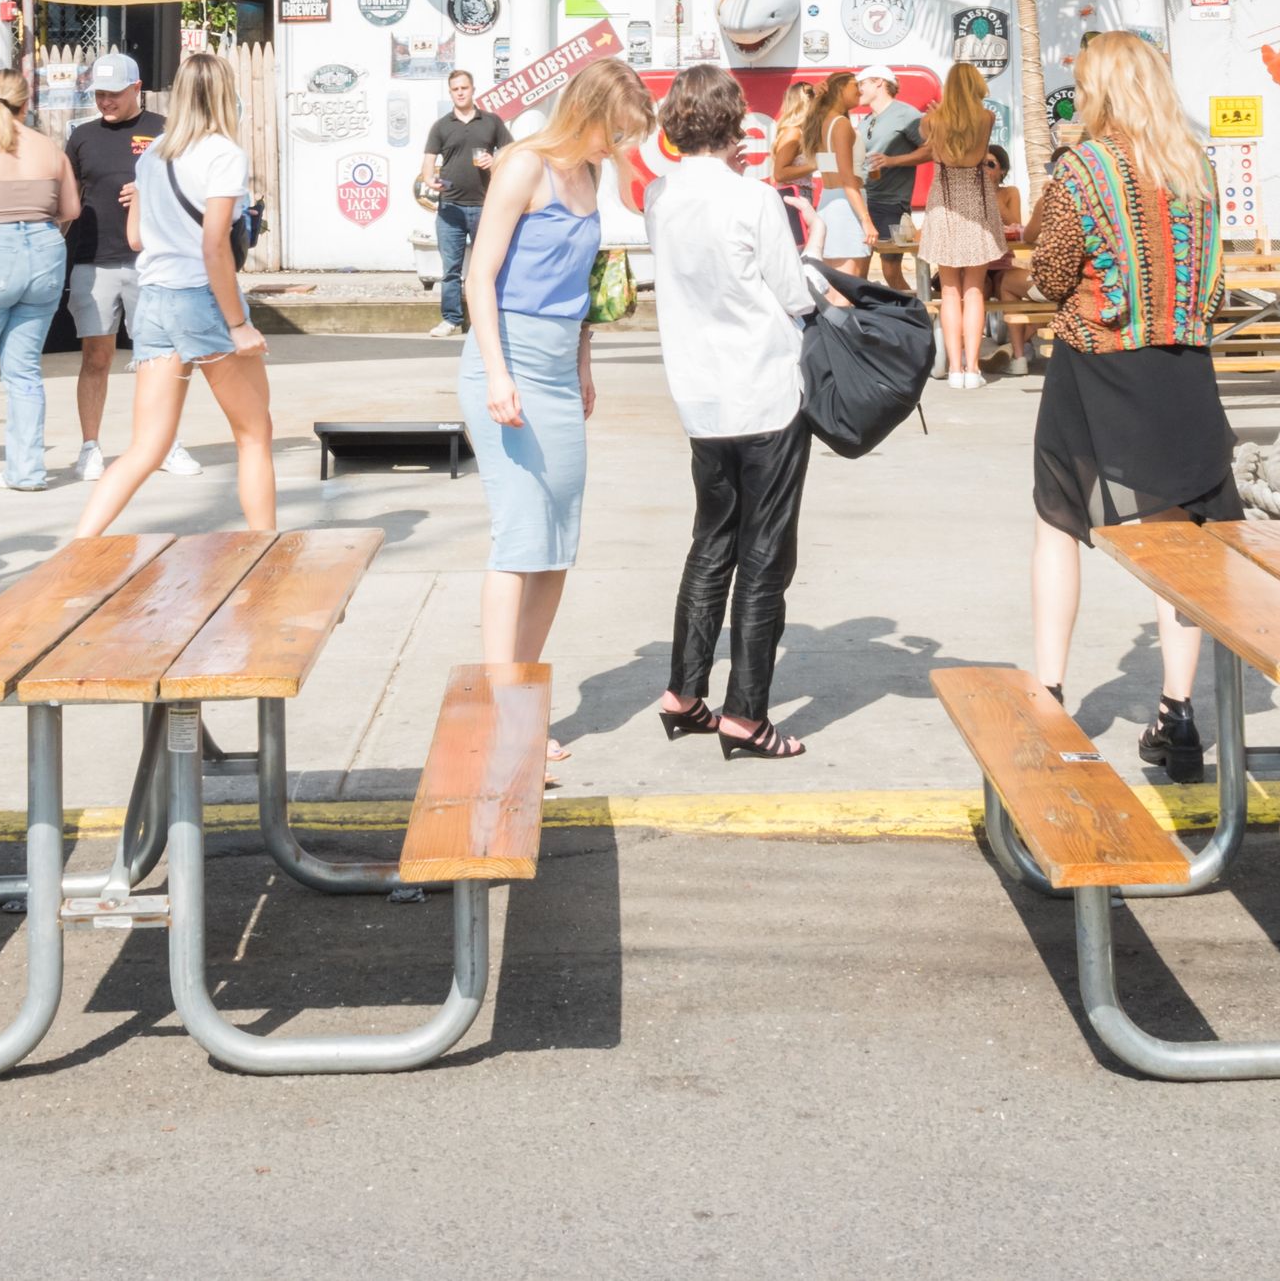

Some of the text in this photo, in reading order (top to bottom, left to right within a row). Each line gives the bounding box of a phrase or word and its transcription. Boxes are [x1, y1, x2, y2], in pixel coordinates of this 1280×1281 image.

[282, 2, 329, 17] BREWERY
[868, 10, 887, 33] 7
[958, 8, 1004, 37] FIRESTONE
[956, 41, 1006, 59] PIVO
[987, 60, 1004, 68] PILS
[481, 36, 593, 113] FRESH LOBSTER
[524, 74, 566, 103] OPEN
[286, 91, 369, 116] Toasted
[1046, 90, 1076, 126] FIRESTO
[339, 187, 388, 200] UNION
[346, 199, 381, 212] JACK
[355, 210, 372, 221] IPA
